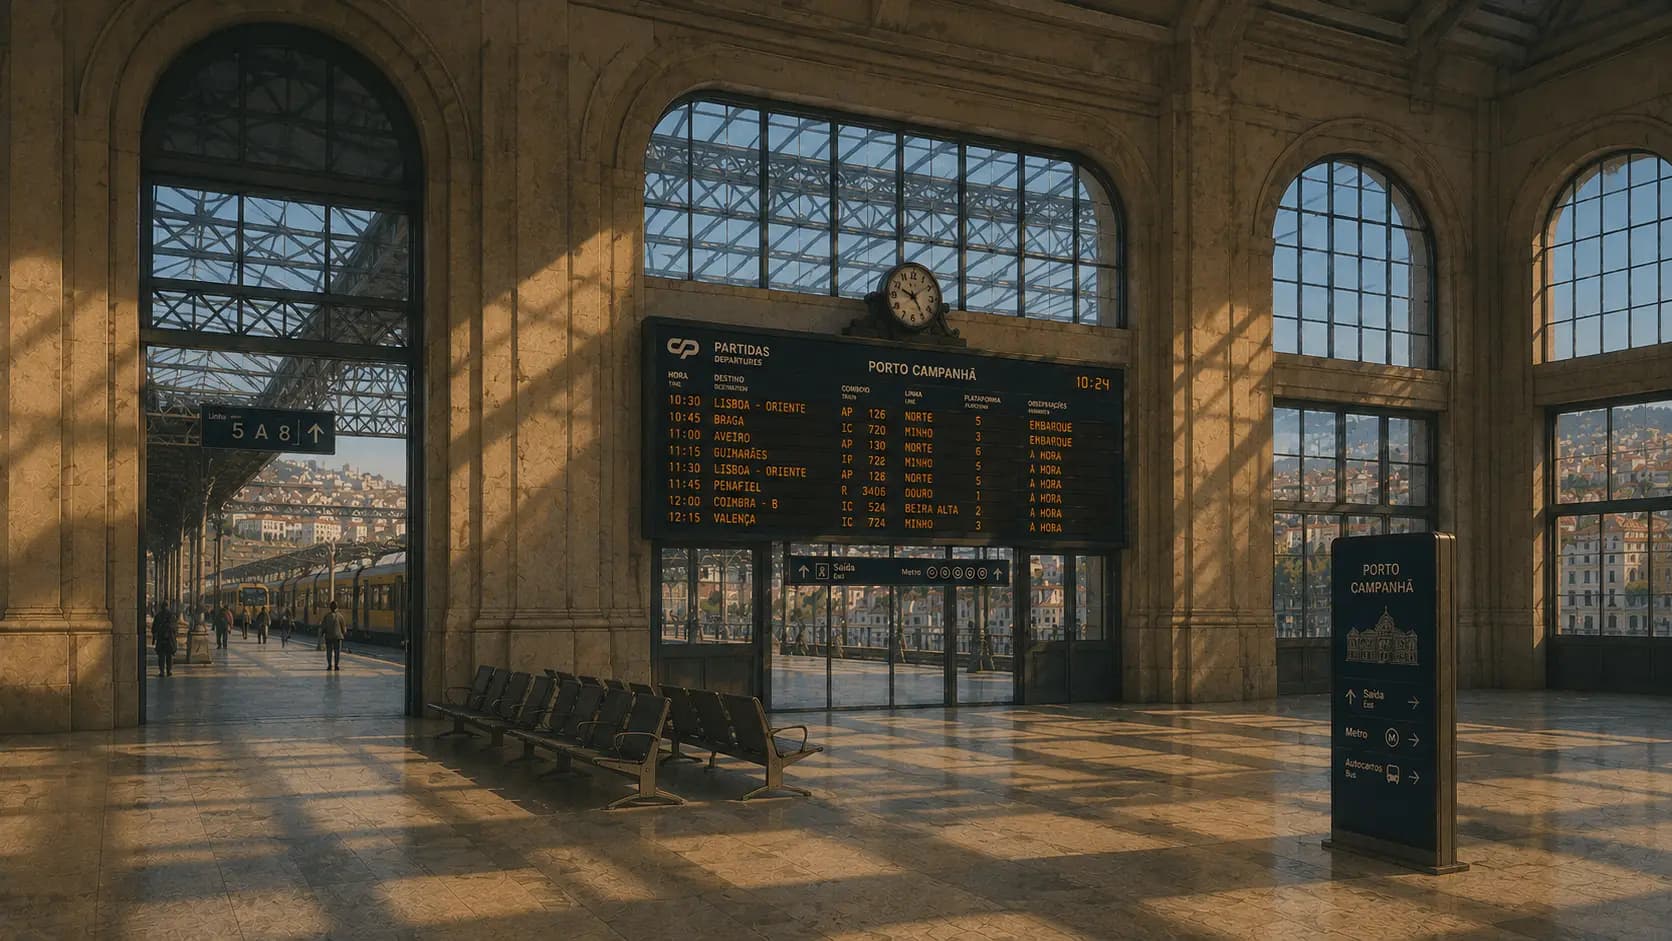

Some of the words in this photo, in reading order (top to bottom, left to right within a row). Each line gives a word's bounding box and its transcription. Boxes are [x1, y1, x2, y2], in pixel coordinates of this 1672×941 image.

[714, 342, 770, 357] PARTIDAS
[868, 360, 908, 375] PORTO
[912, 364, 976, 380] CAMPANHÃ
[1076, 376, 1110, 391] 10:24
[669, 394, 701, 406] 10:30
[714, 398, 750, 410] LISBOA
[766, 401, 806, 414] ORIENTE
[841, 407, 853, 416] AP
[868, 409, 886, 420] 126
[904, 412, 933, 423] NORTE
[975, 416, 982, 426] 5
[232, 422, 244, 439] 5
[254, 424, 268, 440] A
[280, 425, 290, 441] 8
[669, 412, 701, 424] 10:45
[714, 414, 744, 426] BRAGA
[842, 424, 853, 433] IC
[868, 425, 886, 436] 720
[904, 426, 934, 438] MINHO
[975, 432, 981, 442] 3
[669, 428, 701, 440] 11:00
[841, 440, 853, 449] AP
[869, 441, 886, 451] 130
[904, 442, 933, 454] NORTE
[975, 446, 981, 456] 6
[1040, 451, 1062, 461] HORA
[669, 446, 701, 456] 11:15
[904, 458, 933, 468] MINHO
[975, 461, 981, 471] 5
[1040, 465, 1062, 475] HORA
[669, 462, 701, 473] 11:30
[714, 464, 750, 475] LISBOA
[766, 466, 806, 478] ORIENTE
[841, 470, 854, 480] AP
[904, 473, 933, 484] NORTE
[975, 476, 981, 486] 5
[1040, 479, 1062, 489] HORA
[669, 479, 701, 490] 11:45
[714, 480, 760, 492] PENAFIEL
[841, 486, 848, 496] R
[904, 488, 933, 499] DOURO
[976, 490, 981, 500] 1
[1040, 494, 1062, 504] HORA
[669, 496, 701, 506] 12:00
[771, 498, 778, 509] B
[842, 501, 853, 512] IC
[868, 502, 886, 512] 524
[904, 504, 934, 514] BEIRA
[936, 505, 959, 515] ALTA
[975, 506, 981, 516] 2
[1040, 508, 1062, 518] HORA
[669, 512, 701, 522] 12:15
[842, 517, 853, 528] IC
[868, 518, 886, 528] 724
[904, 519, 934, 529] MINHO
[975, 520, 981, 531] 3
[1040, 522, 1062, 532] HORA
[902, 568, 921, 576] Metro
[1363, 563, 1400, 576] PORTO
[1350, 578, 1414, 594] CAMPANHÃ
[1346, 728, 1368, 740] Metro
